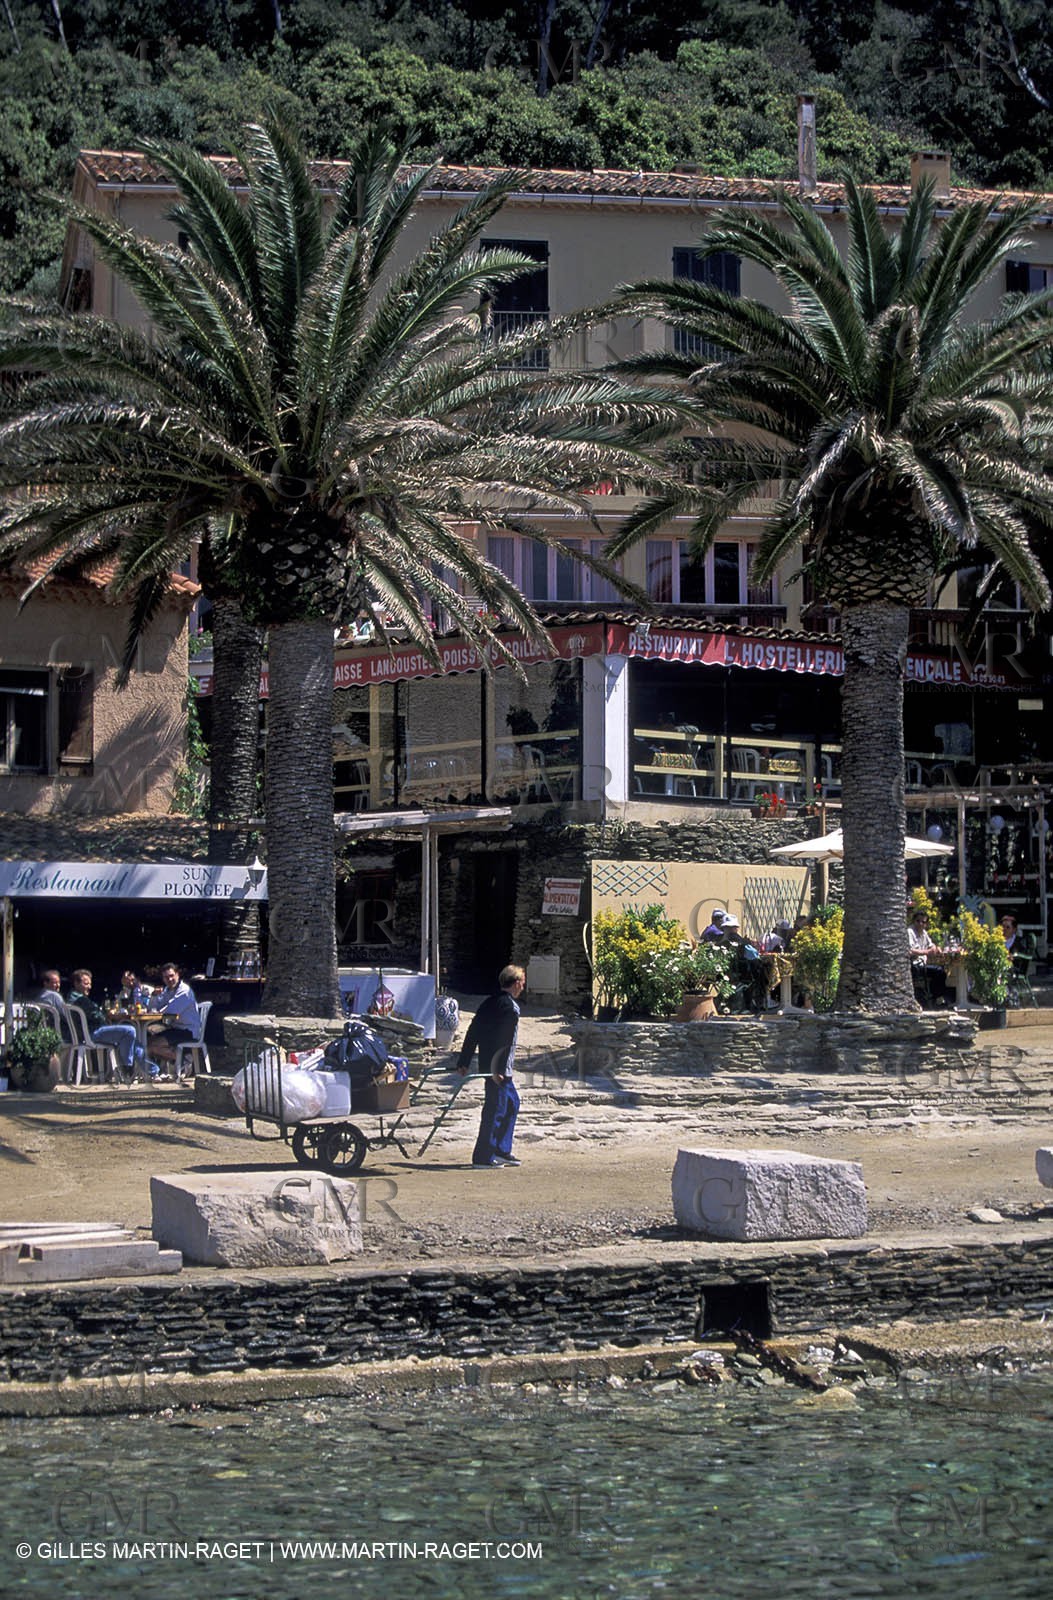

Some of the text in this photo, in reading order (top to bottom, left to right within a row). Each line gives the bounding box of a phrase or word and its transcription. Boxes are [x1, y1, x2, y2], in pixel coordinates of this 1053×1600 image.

[628, 632, 704, 655] RESTAURANT
[371, 653, 433, 676] LANGOUSTE
[10, 868, 129, 891] Restaurant
[183, 867, 213, 880] SUN
[164, 883, 231, 897] PLONGEE
